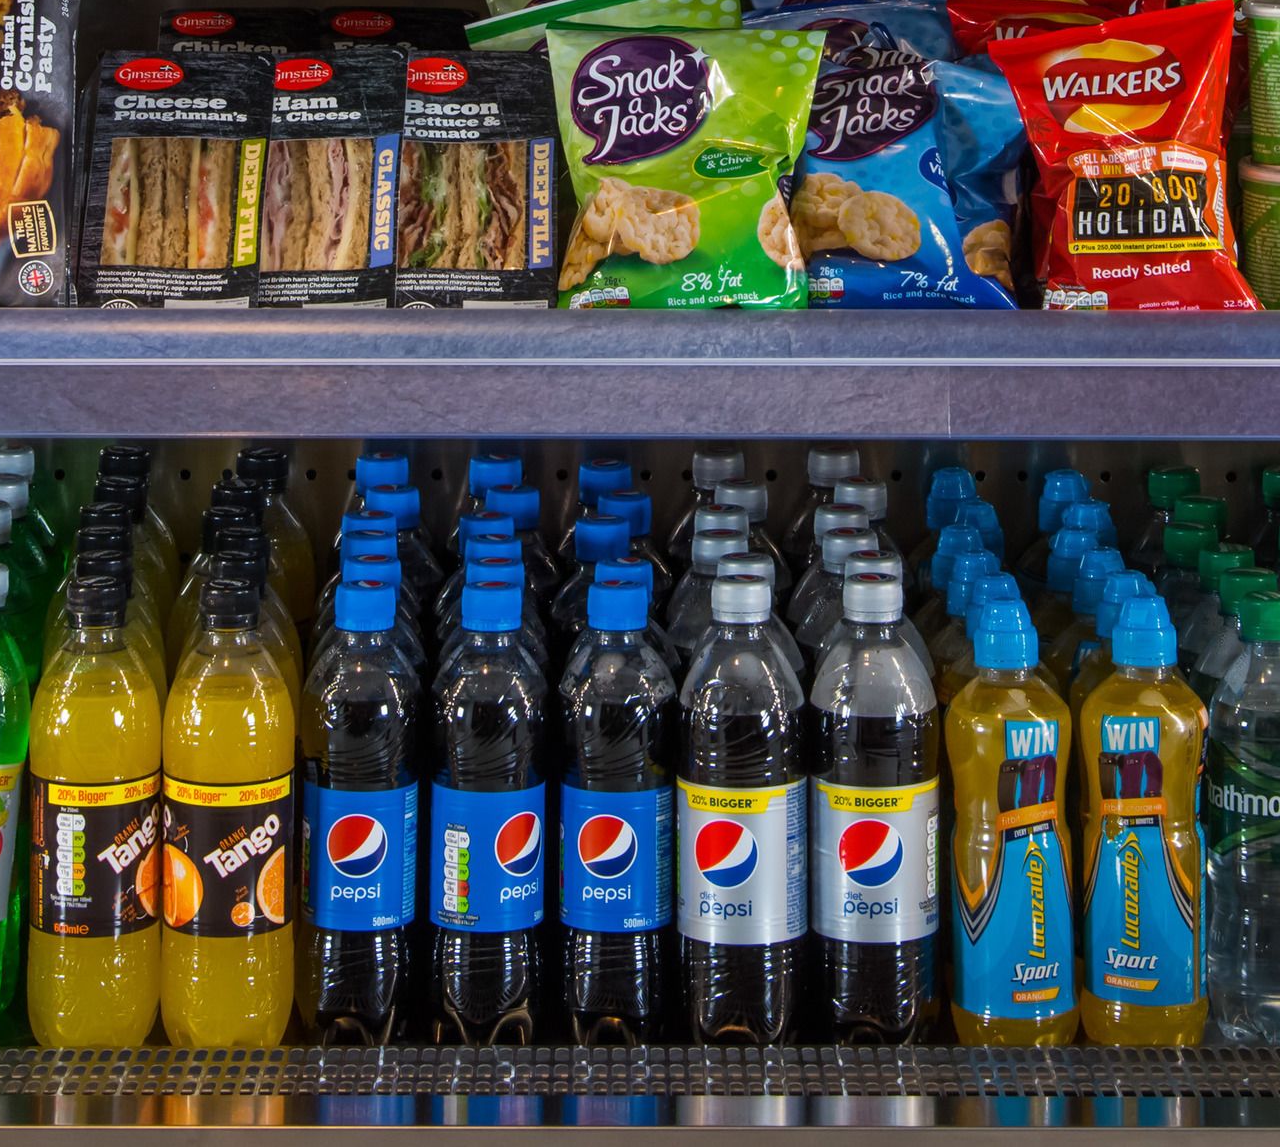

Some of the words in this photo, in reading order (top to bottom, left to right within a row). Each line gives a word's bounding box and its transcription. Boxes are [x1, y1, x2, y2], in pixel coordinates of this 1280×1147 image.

[0, 14, 16, 91] Original
[35, 15, 57, 94] Pasty
[578, 49, 694, 106] Snack
[1043, 61, 1182, 102] WALKERS
[114, 95, 228, 110] Cheese
[272, 96, 338, 112] Ham
[405, 101, 500, 116] Bacon
[628, 98, 644, 114] a
[114, 110, 248, 123] Ploughman's
[286, 111, 362, 122] Cheese
[404, 116, 479, 127] Lettuce
[483, 116, 501, 126] &
[404, 128, 480, 139] Tomato
[592, 95, 687, 160] Jacks
[707, 161, 717, 169] &
[720, 155, 752, 166] Chive
[1103, 164, 1121, 175] WIN
[242, 144, 261, 203] DEEP
[374, 149, 393, 251] CLASSIC
[16, 219, 25, 240] THE
[1078, 207, 1202, 235] HOLIDAY
[237, 205, 256, 262] FILL
[1146, 243, 1168, 251] prizes!
[820, 267, 835, 277] 26g
[1092, 266, 1139, 280] Ready
[1143, 260, 1191, 276] Salted
[681, 273, 713, 292] 8%
[719, 270, 743, 293] fat
[901, 271, 928, 288] 7%
[937, 274, 960, 291] fat
[668, 298, 690, 307] Rice
[732, 292, 759, 301] snack
[1011, 725, 1054, 757] WIN
[57, 789, 76, 801] 20%
[203, 814, 280, 878] Tango
[220, 826, 247, 850] ORANGE
[330, 884, 381, 902] pepsi
[699, 892, 718, 901] diet
[1028, 859, 1045, 959] Lucozade
[372, 916, 394, 927] 500ml
[1011, 960, 1059, 984] Sport
